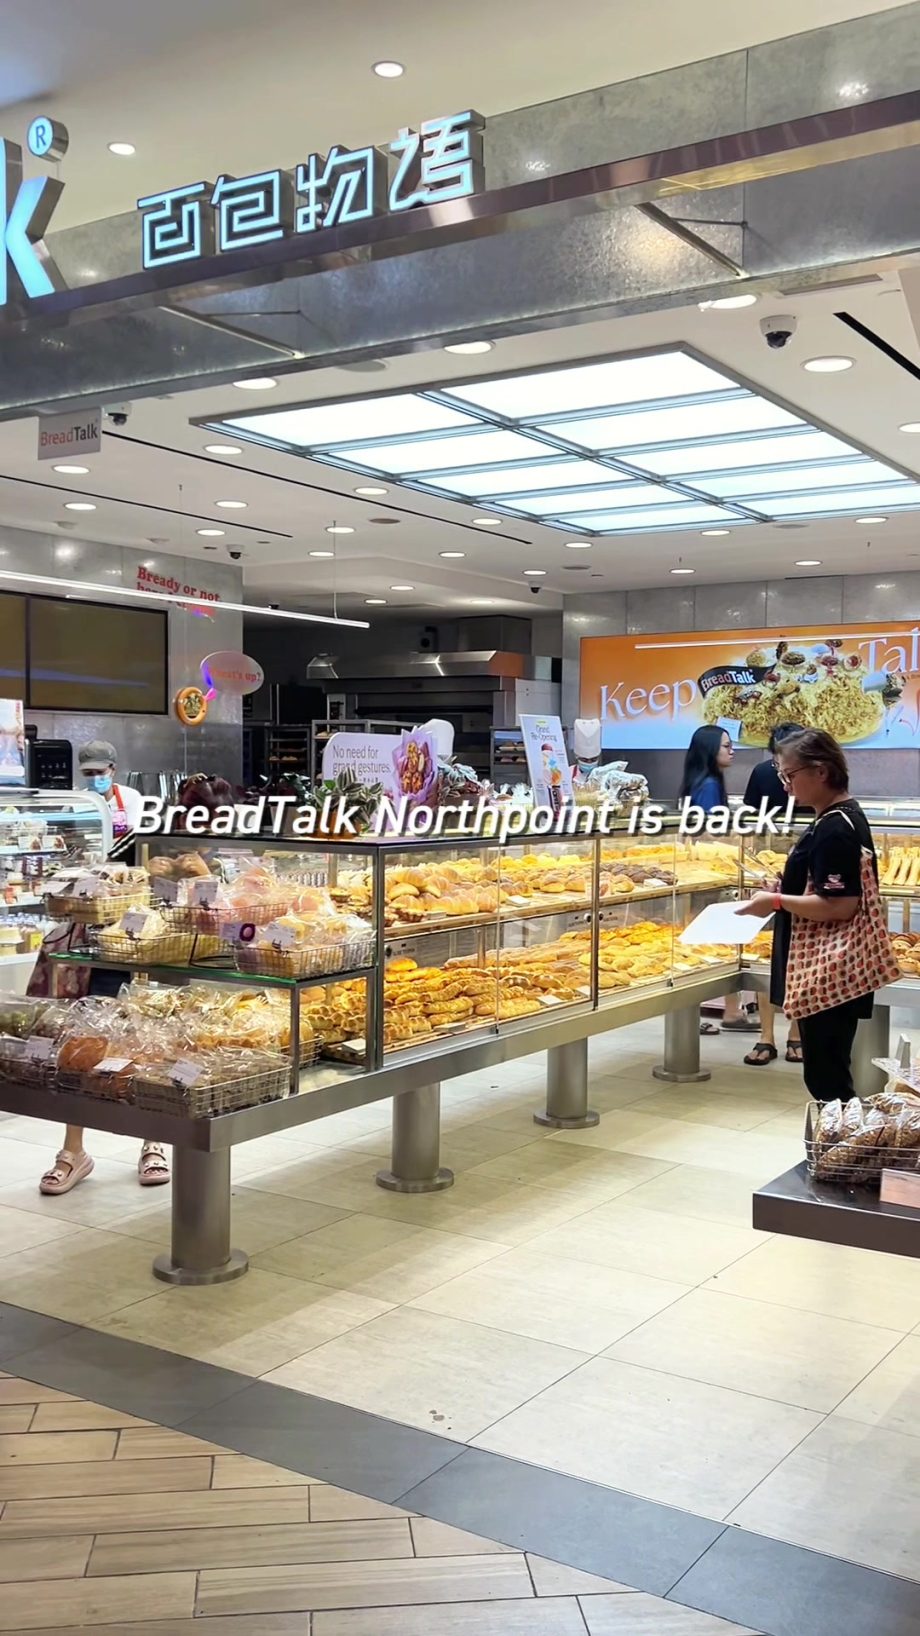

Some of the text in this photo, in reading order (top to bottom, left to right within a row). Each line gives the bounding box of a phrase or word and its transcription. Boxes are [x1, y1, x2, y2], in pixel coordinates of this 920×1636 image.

[40, 423, 98, 446] BreadTalk
[136, 566, 221, 602] Bready or not
[700, 669, 757, 692] BreadTalk
[600, 679, 697, 721] Keep
[332, 745, 379, 759] No need for
[358, 762, 391, 776] gestures.
